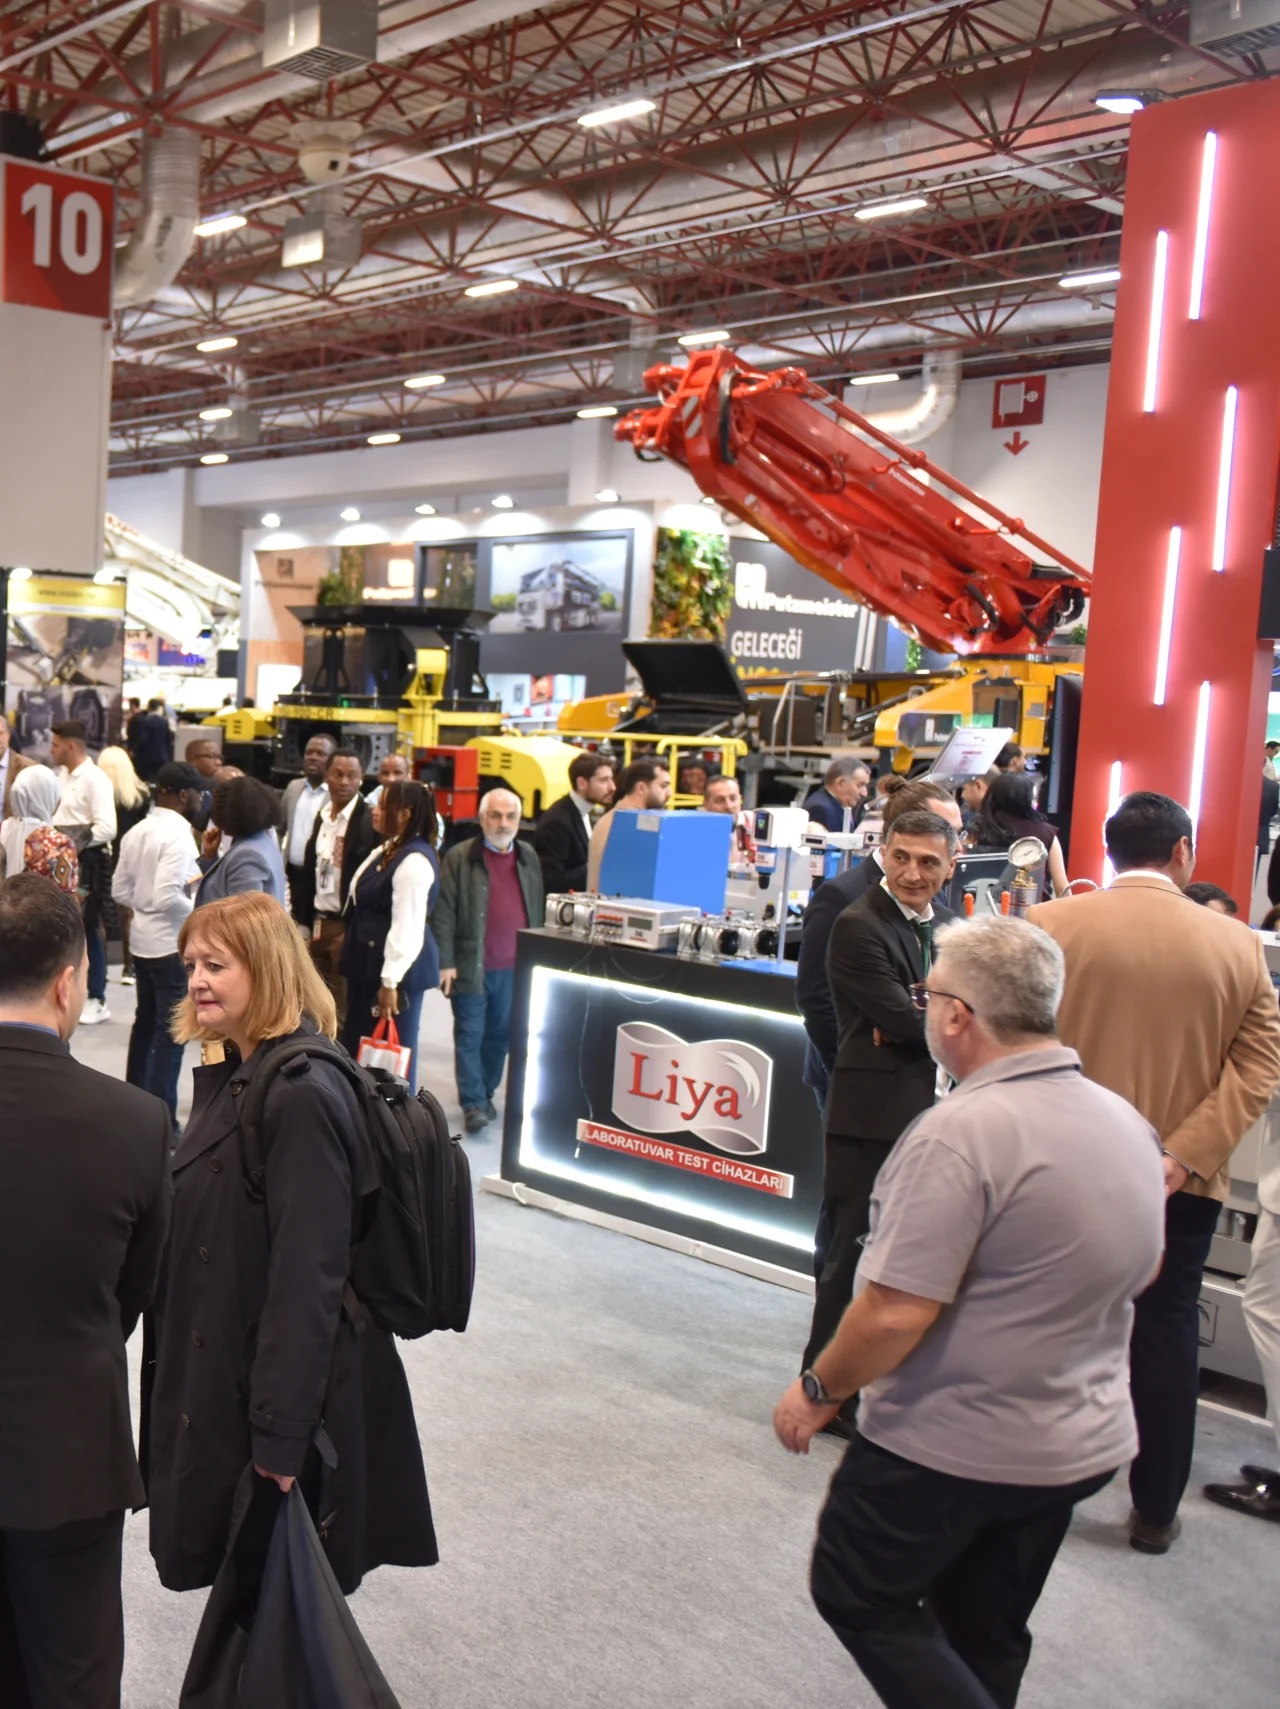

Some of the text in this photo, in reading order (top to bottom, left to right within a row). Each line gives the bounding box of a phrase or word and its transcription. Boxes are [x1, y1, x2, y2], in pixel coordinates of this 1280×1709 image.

[21, 182, 104, 275] 10
[731, 627, 803, 660] GELECEĞİ
[627, 1051, 742, 1121] Liya
[584, 1126, 784, 1190] LABORATUVAR TEST CİHAZLARI
